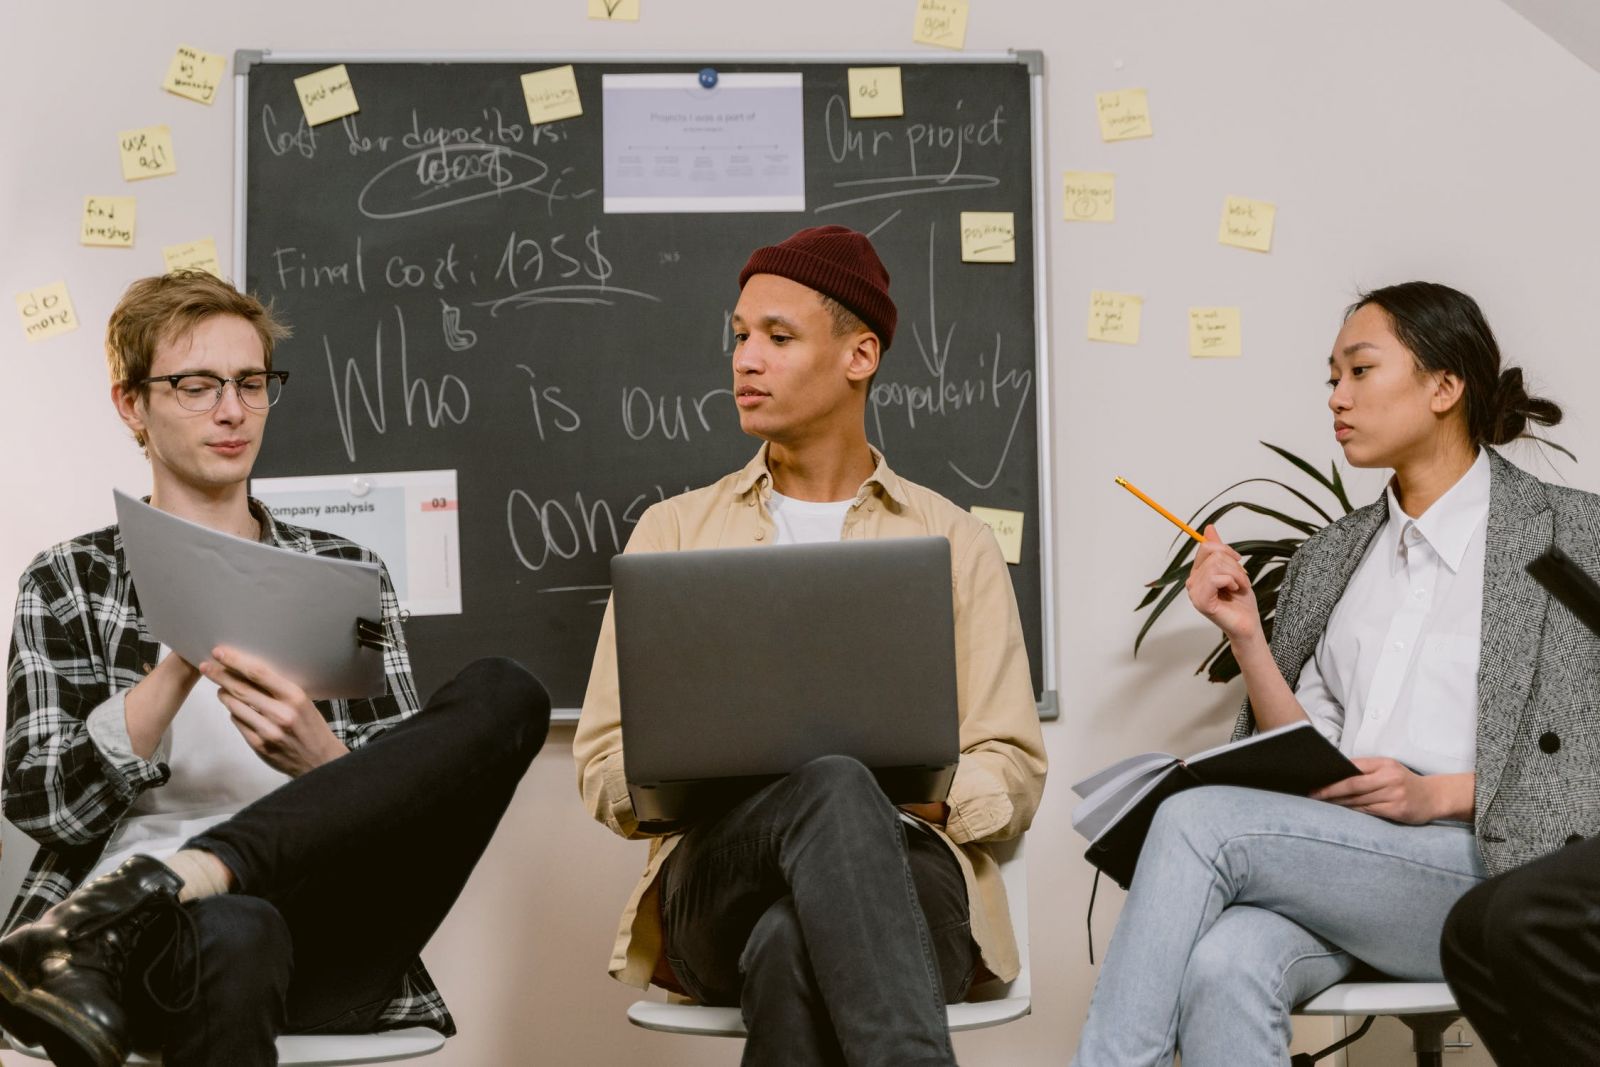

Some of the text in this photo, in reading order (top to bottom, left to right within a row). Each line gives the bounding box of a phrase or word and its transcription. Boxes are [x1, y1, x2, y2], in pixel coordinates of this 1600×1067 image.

[825, 94, 1007, 185] Our project
[273, 236, 366, 293] Final
[495, 226, 613, 292] 175$
[22, 292, 59, 317] do
[26, 310, 71, 335] more
[323, 304, 734, 462] Who is our
[267, 501, 375, 518] ompany analysis
[432, 498, 447, 509] 03
